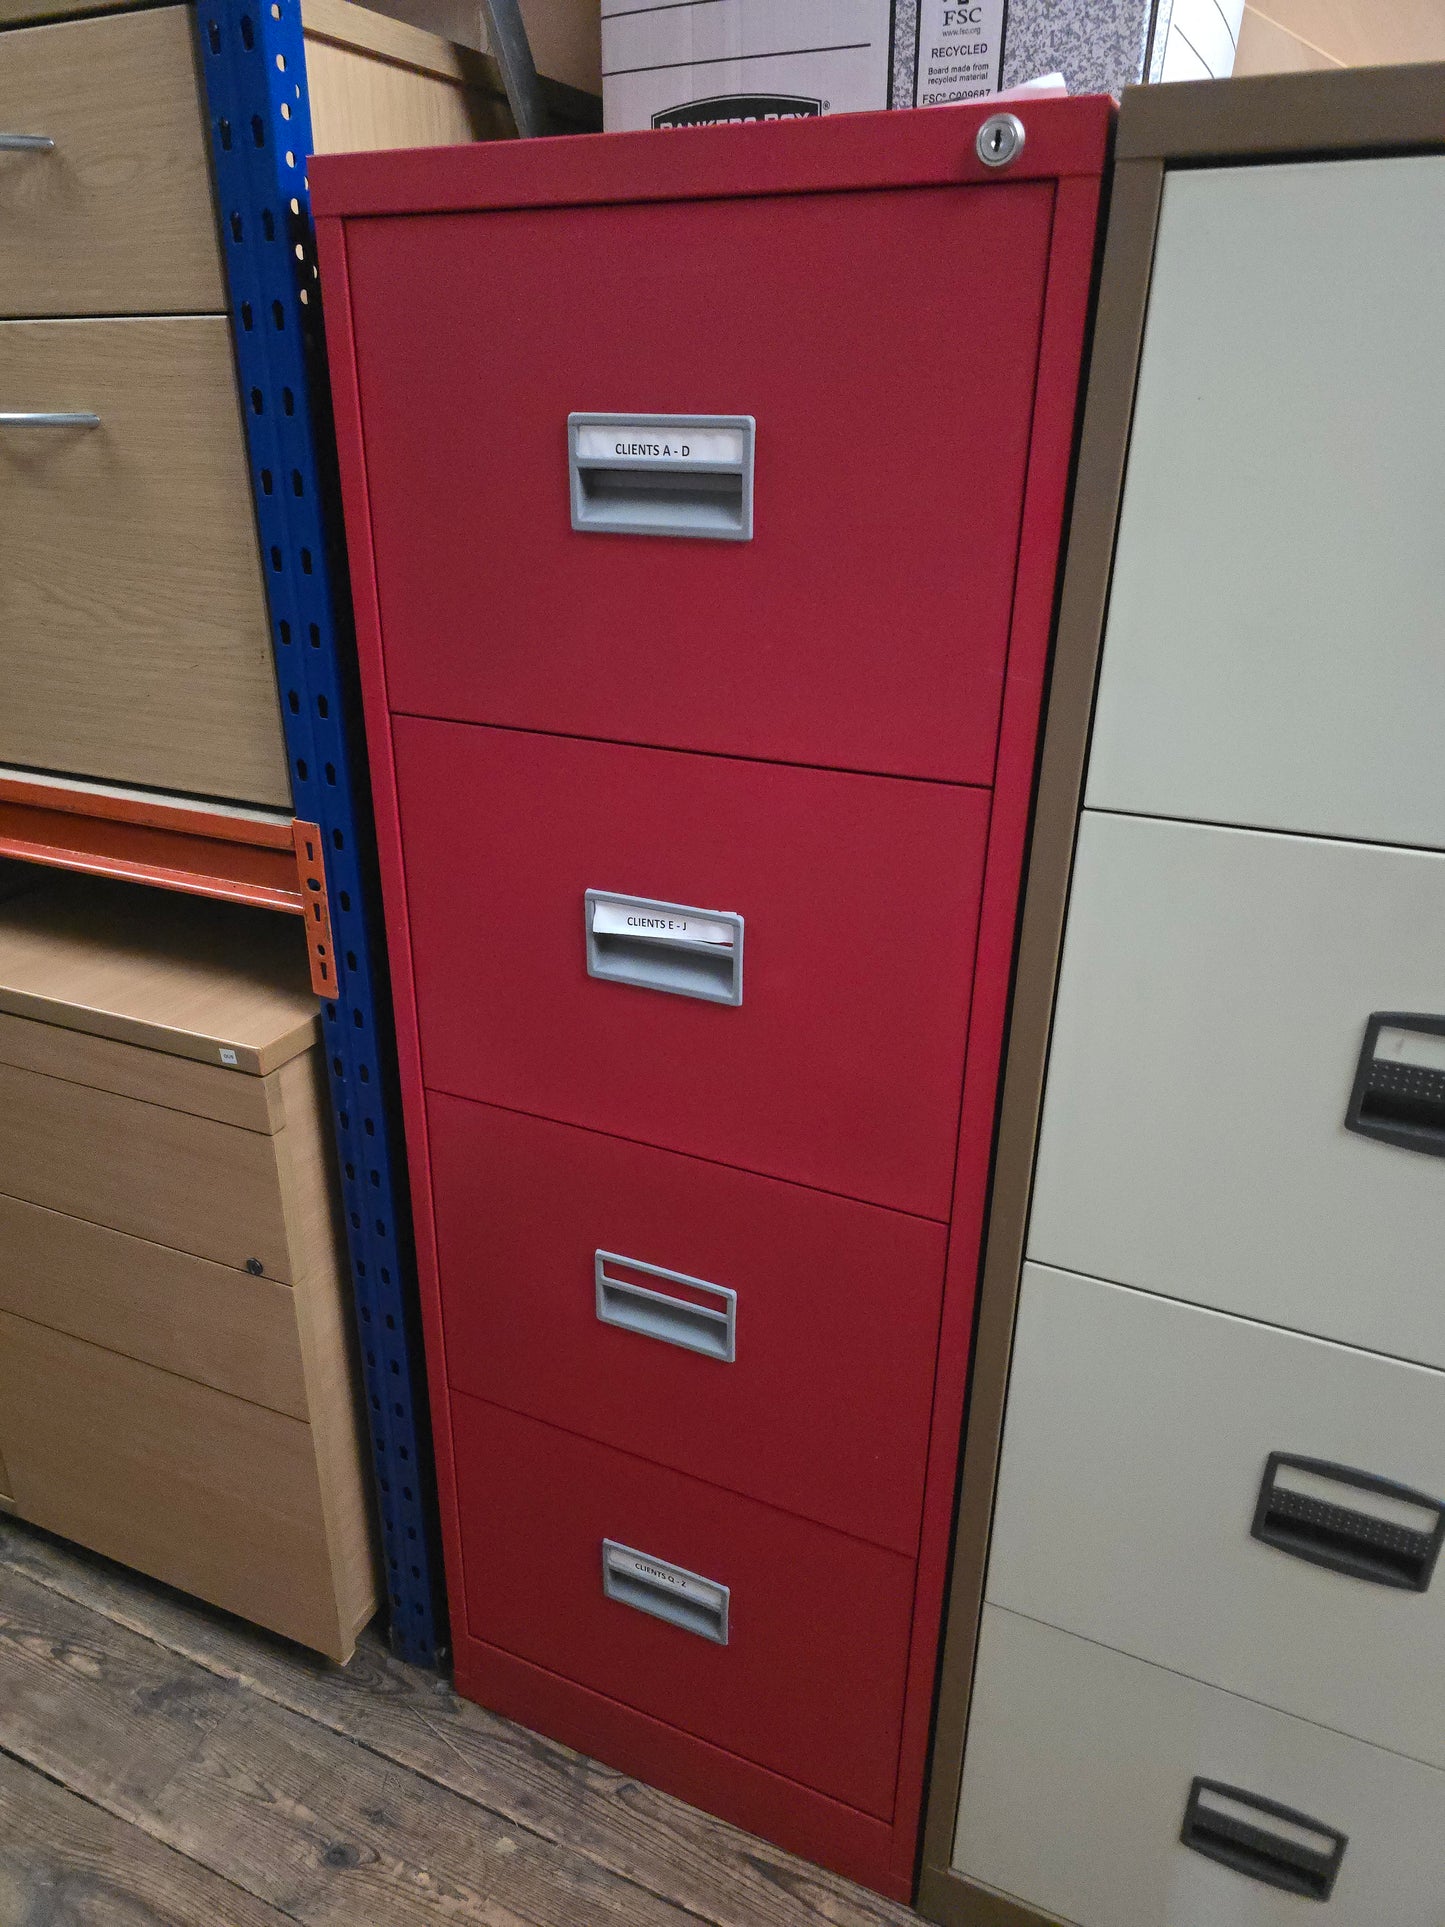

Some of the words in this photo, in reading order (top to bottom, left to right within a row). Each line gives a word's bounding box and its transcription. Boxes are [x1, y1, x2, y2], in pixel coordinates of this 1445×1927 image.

[943, 7, 982, 26] FSC
[942, 27, 981, 36] www.fsc.org
[931, 43, 988, 59] RECYCLED
[928, 66, 949, 76] Board
[951, 64, 971, 73] made
[973, 63, 989, 71] from
[928, 75, 958, 85] recycled
[959, 72, 988, 81] material
[615, 443, 660, 456] CLIENTS
[663, 444, 671, 457] A
[682, 445, 690, 457] D
[627, 916, 666, 929] CLIENTS
[668, 921, 674, 929] E
[682, 922, 687, 931] J
[635, 1563, 666, 1579] CLIENTS
[668, 1575, 675, 1584] Q
[681, 1580, 687, 1588] Z
